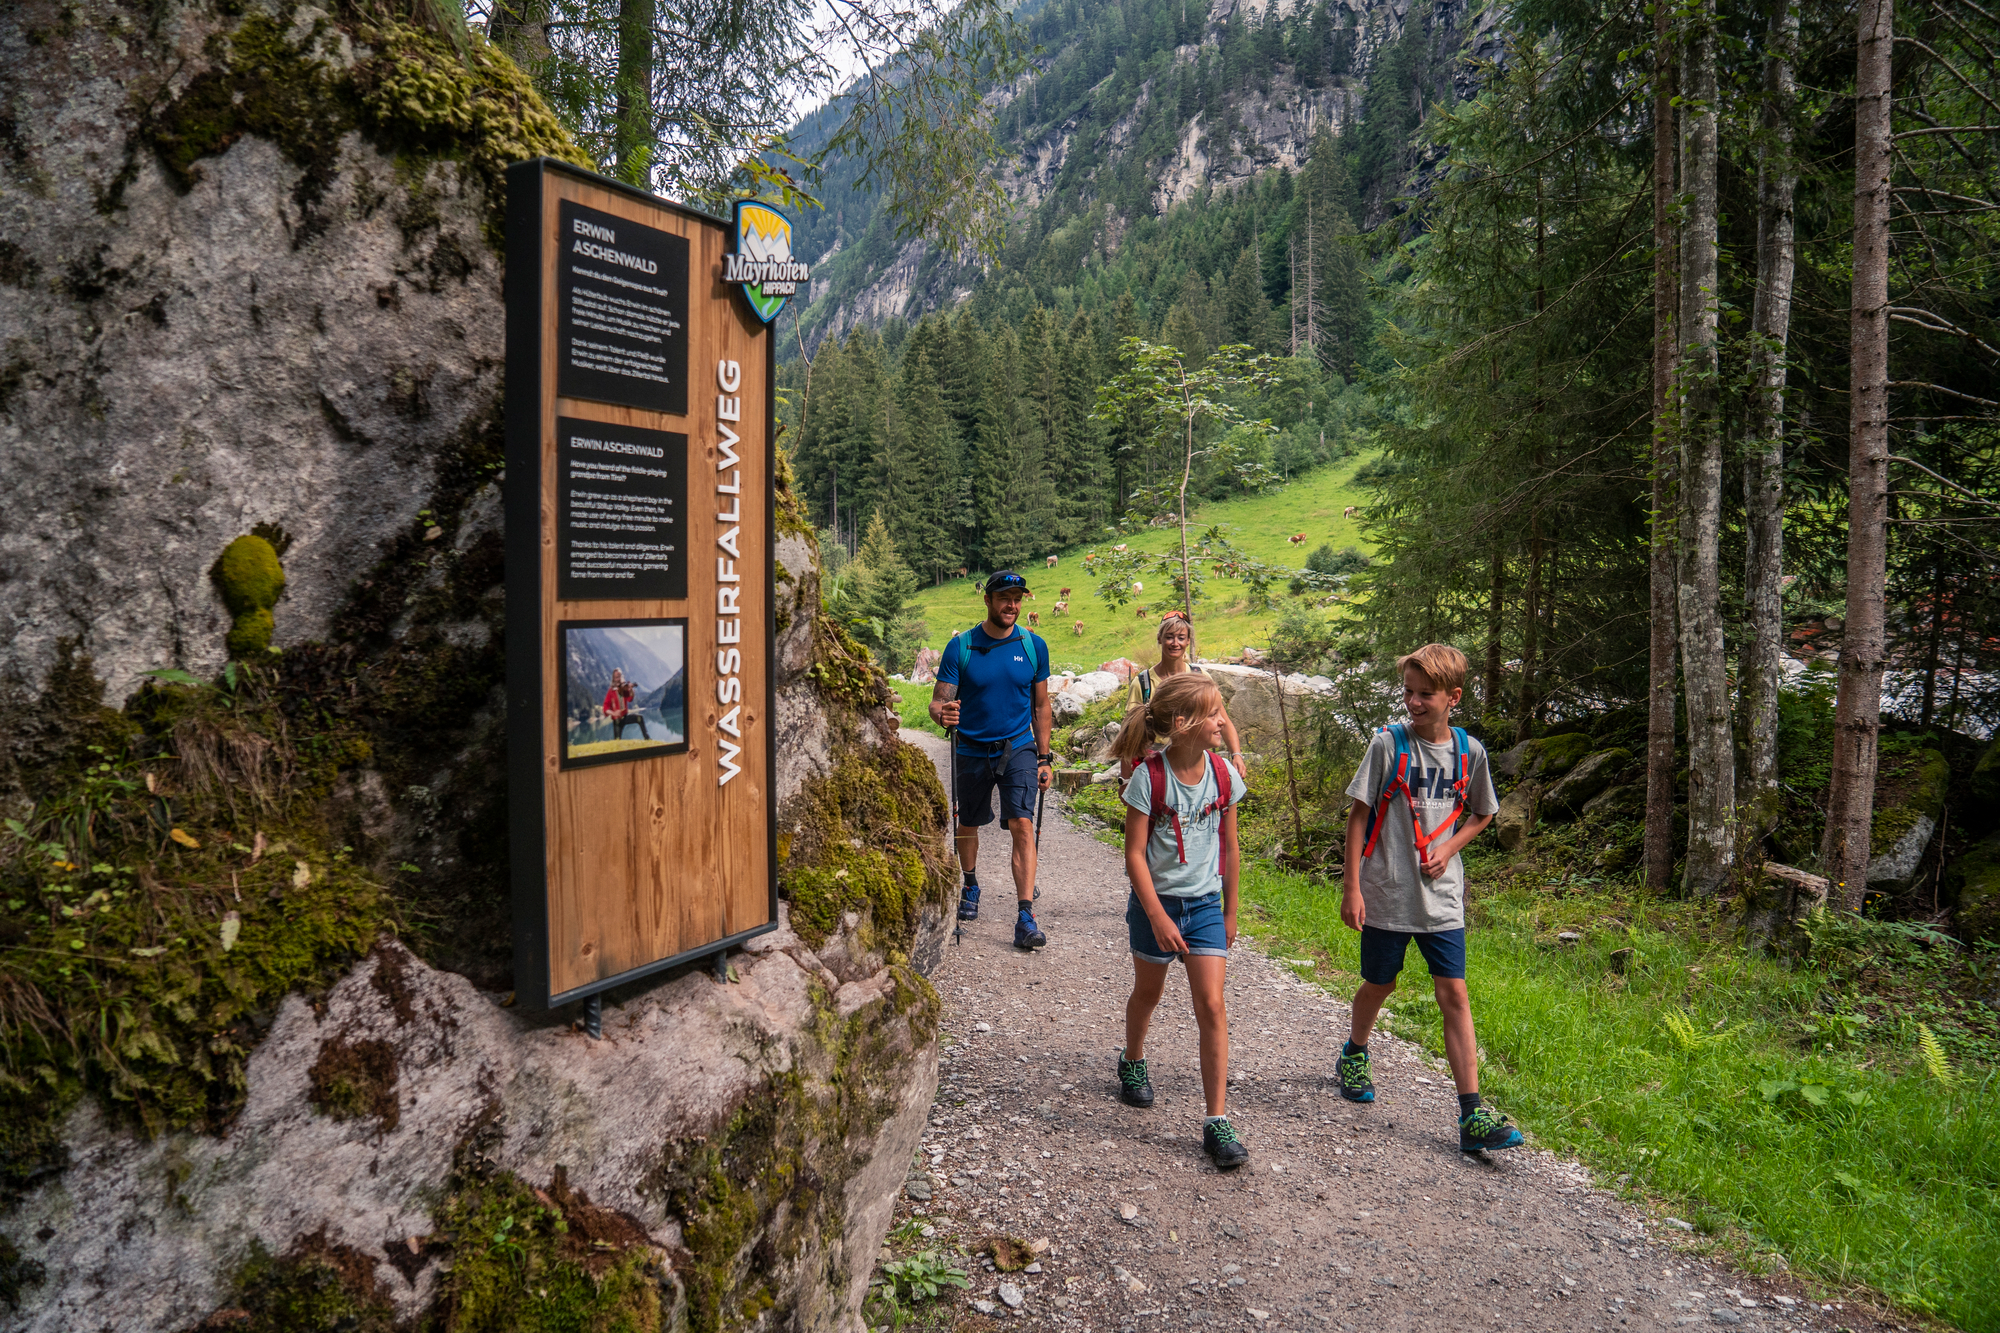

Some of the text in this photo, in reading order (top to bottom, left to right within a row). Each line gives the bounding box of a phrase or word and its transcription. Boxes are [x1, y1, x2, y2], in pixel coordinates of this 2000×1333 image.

[574, 219, 614, 243] ERWIN
[574, 241, 657, 273] ASCHENWALD
[725, 253, 810, 287] Mayrhofen
[762, 281, 797, 295] HIPPACH
[571, 437, 663, 457] ERWIN ASCHENWALD
[717, 359, 741, 786] WASSERFALLWEG
